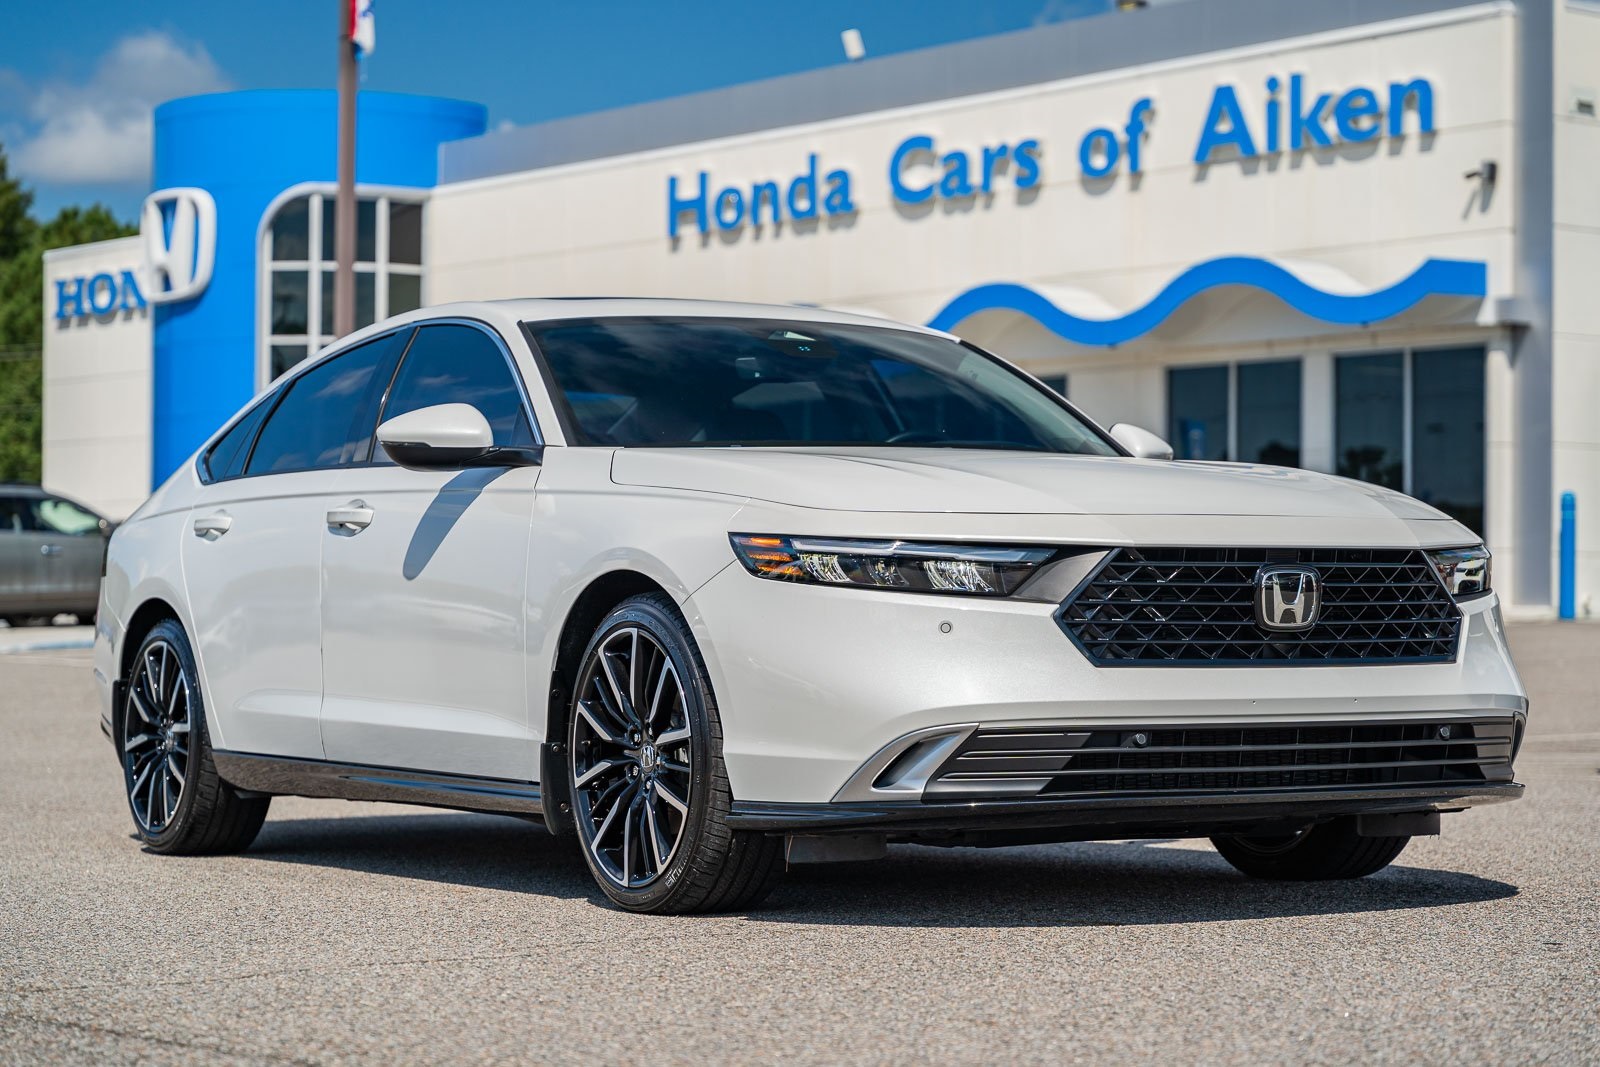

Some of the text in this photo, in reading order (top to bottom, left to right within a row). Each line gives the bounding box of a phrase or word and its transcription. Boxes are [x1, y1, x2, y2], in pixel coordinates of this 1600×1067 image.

[668, 73, 1434, 237] Honda Cars of Aiken
